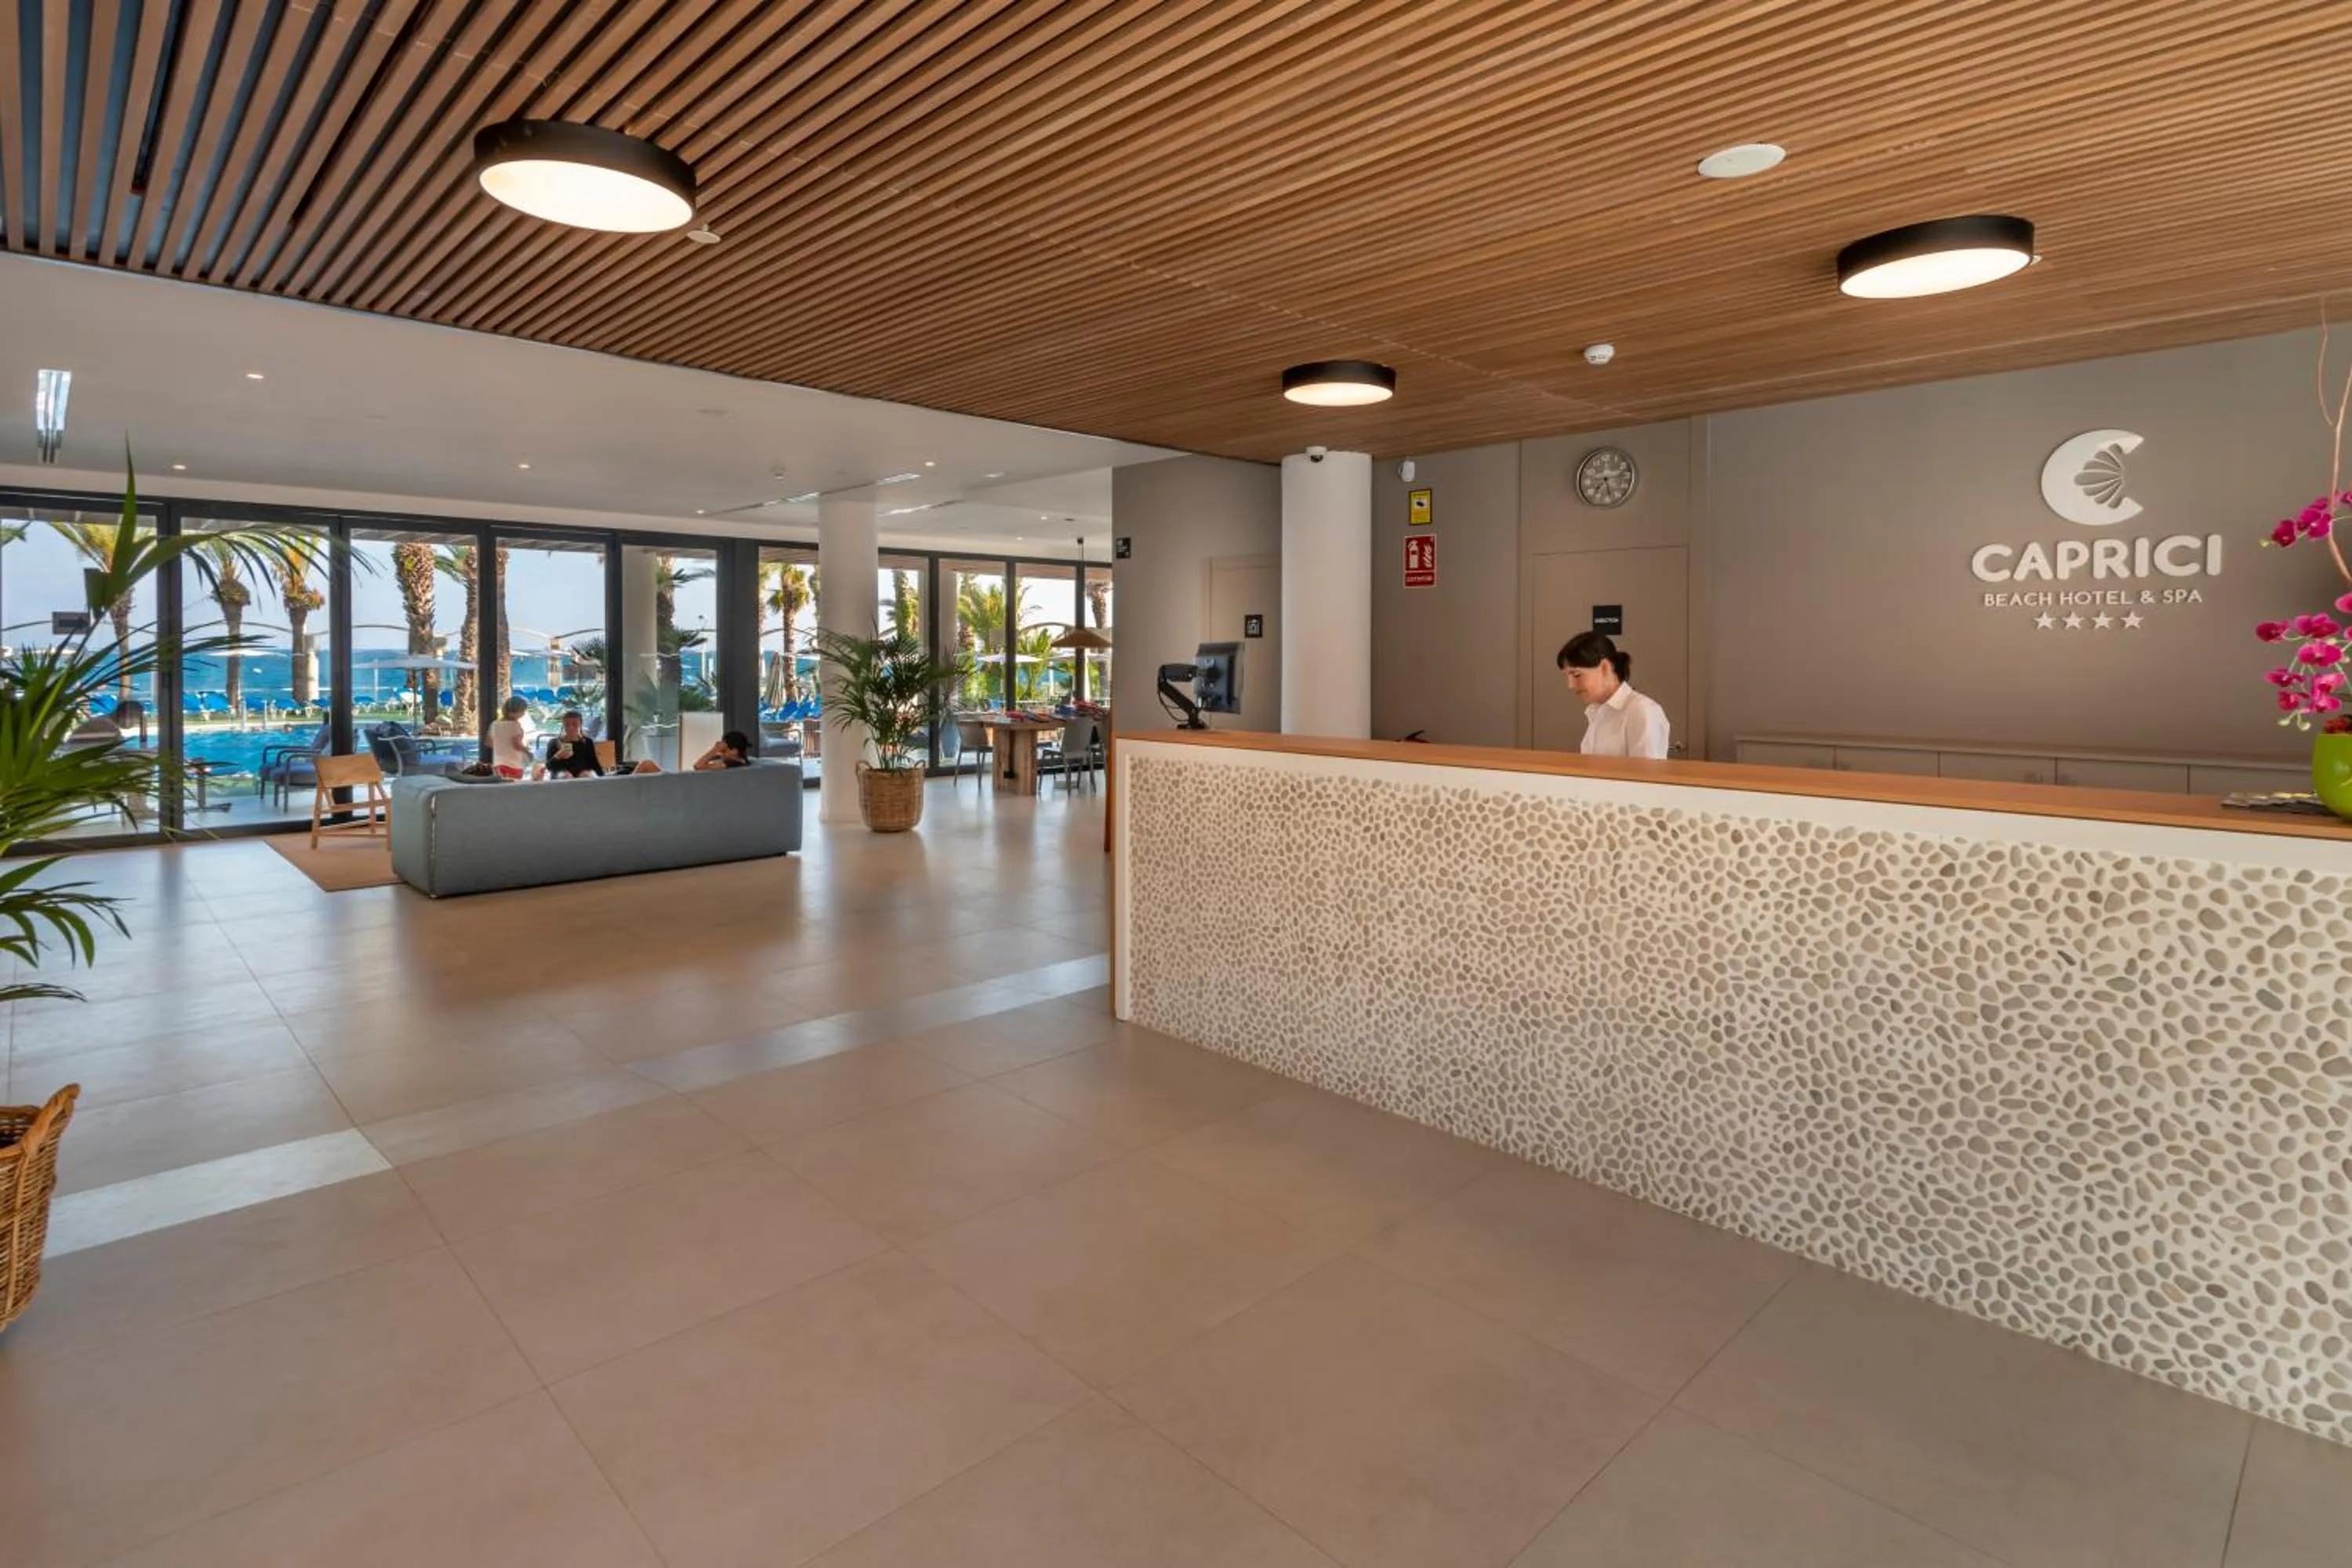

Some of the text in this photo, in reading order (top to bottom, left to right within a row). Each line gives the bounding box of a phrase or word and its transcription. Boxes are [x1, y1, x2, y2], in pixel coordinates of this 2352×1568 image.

[1972, 535, 2222, 582] CAPRICI
[1984, 590, 2202, 606] BEACH HOTEL & SPA
